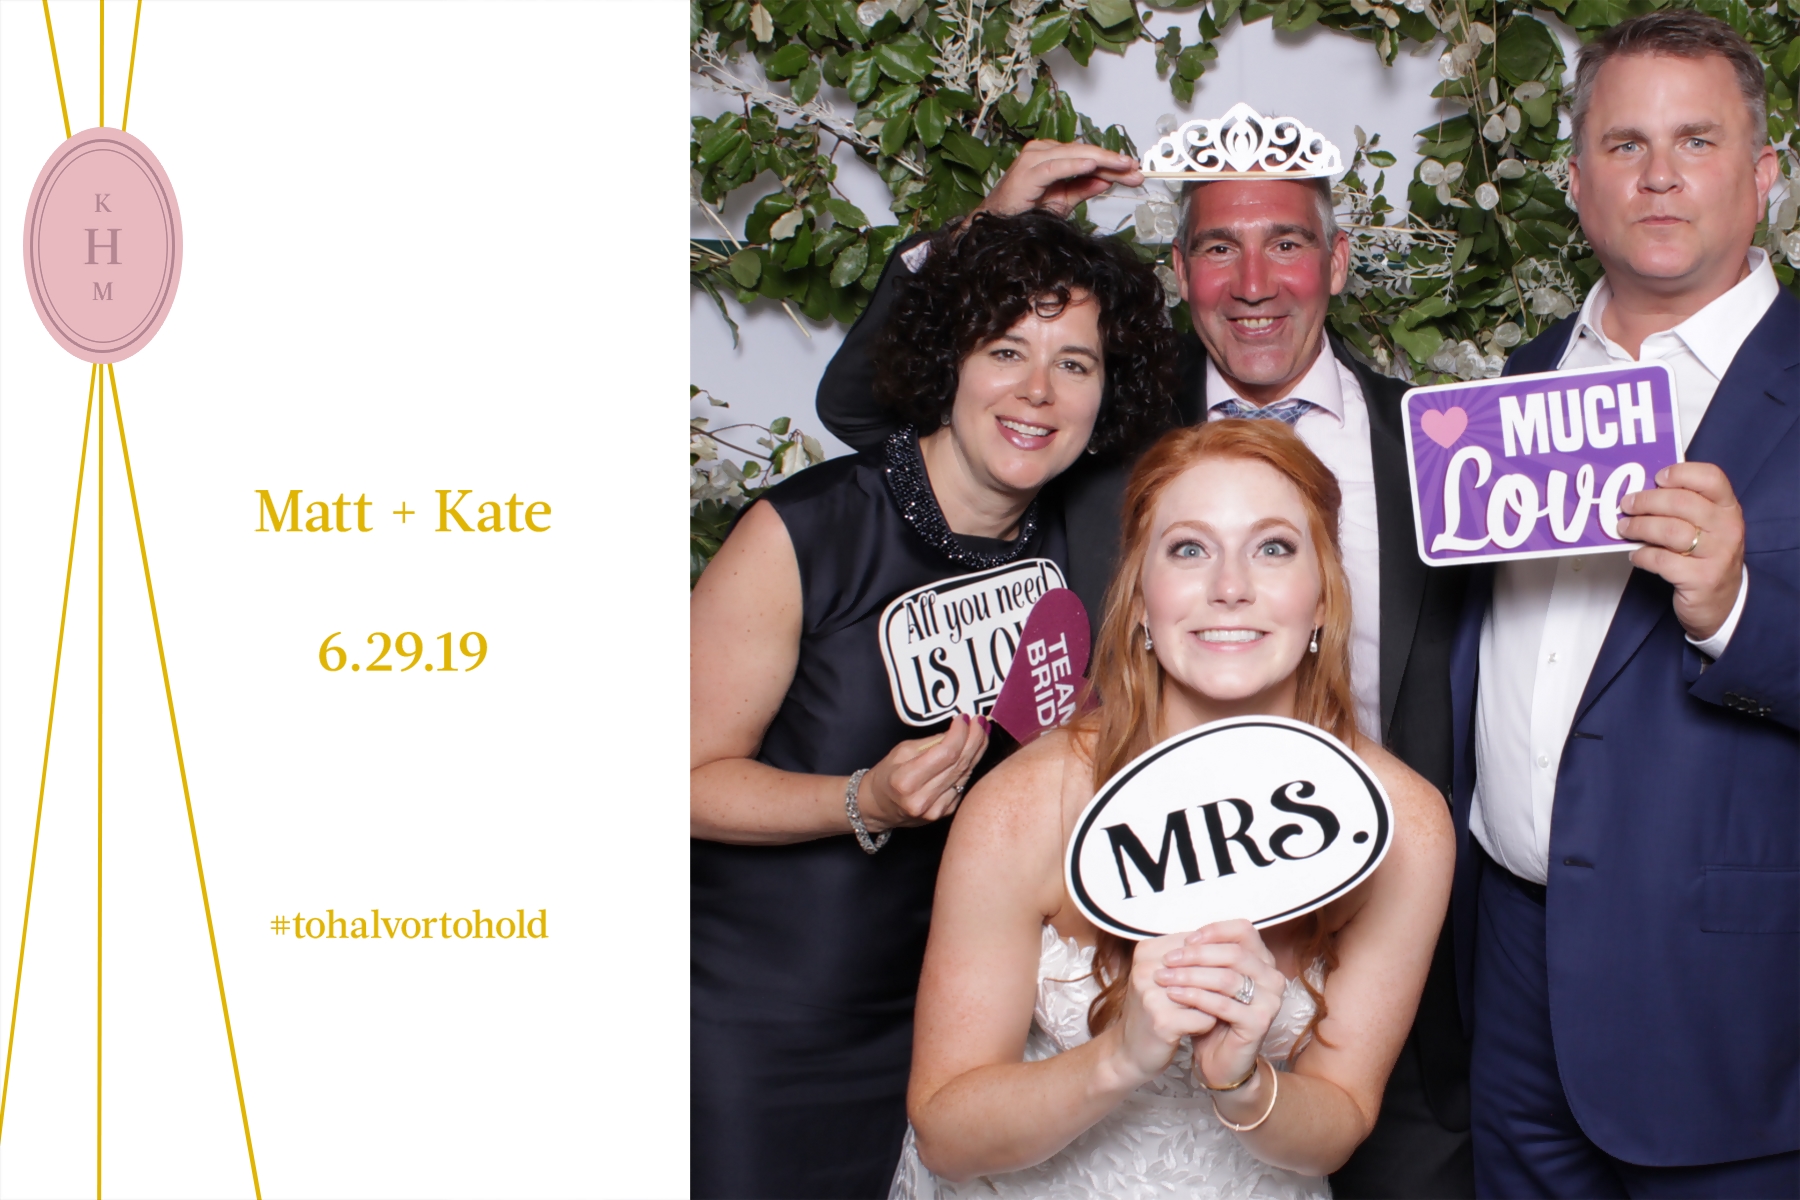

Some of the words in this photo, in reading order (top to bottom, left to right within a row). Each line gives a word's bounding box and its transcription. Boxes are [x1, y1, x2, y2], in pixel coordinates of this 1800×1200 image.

[1499, 381, 1656, 457] MUCH
[1431, 445, 1646, 552] Love
[906, 593, 939, 644] All
[943, 591, 991, 644] you
[995, 562, 1050, 614] need
[911, 647, 960, 714] IS
[964, 621, 1022, 694] LO
[1026, 638, 1058, 736] BRID
[1100, 780, 1369, 900] MRS.
